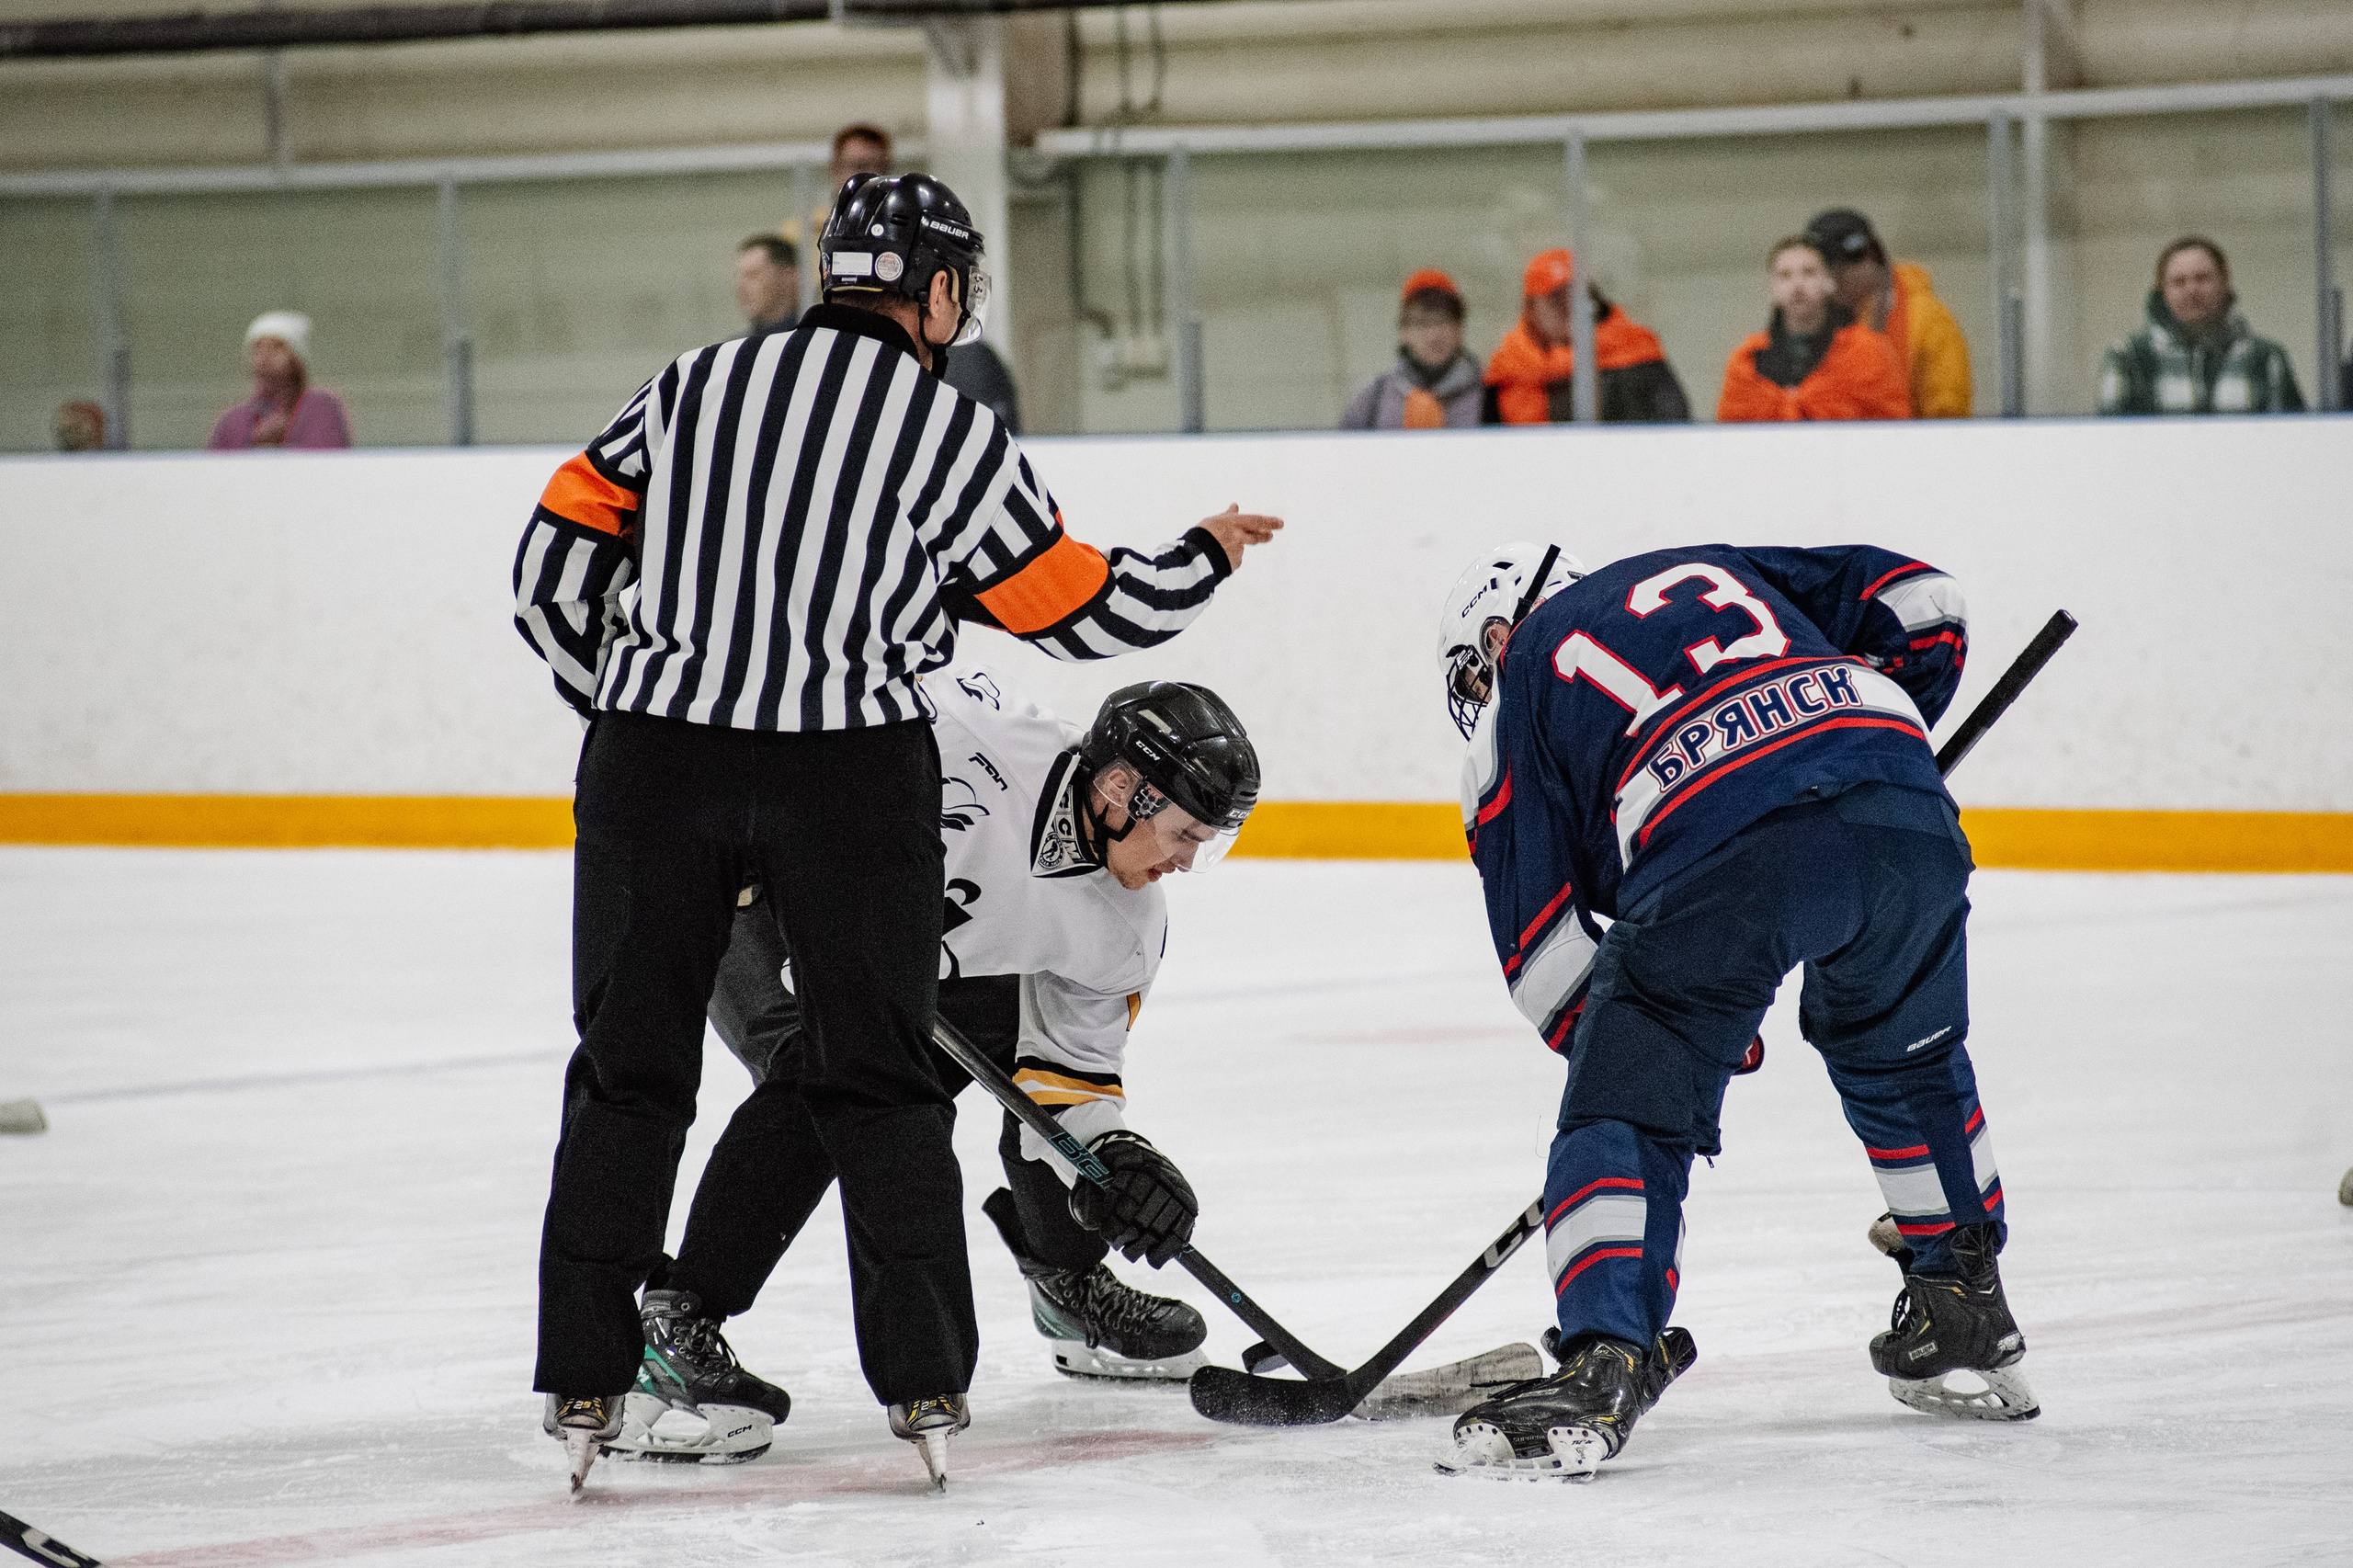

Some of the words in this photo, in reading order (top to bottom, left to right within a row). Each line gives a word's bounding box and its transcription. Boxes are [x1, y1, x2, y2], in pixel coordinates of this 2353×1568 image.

[929, 221, 970, 240] BAUER
[1461, 585, 1488, 619] CCM
[1551, 562, 1791, 738] 13
[1646, 664, 1863, 793] БРЯНСК
[1135, 740, 1161, 762] CCM
[1906, 1026, 1952, 1052] BAUER
[727, 1424, 753, 1438] CCM
